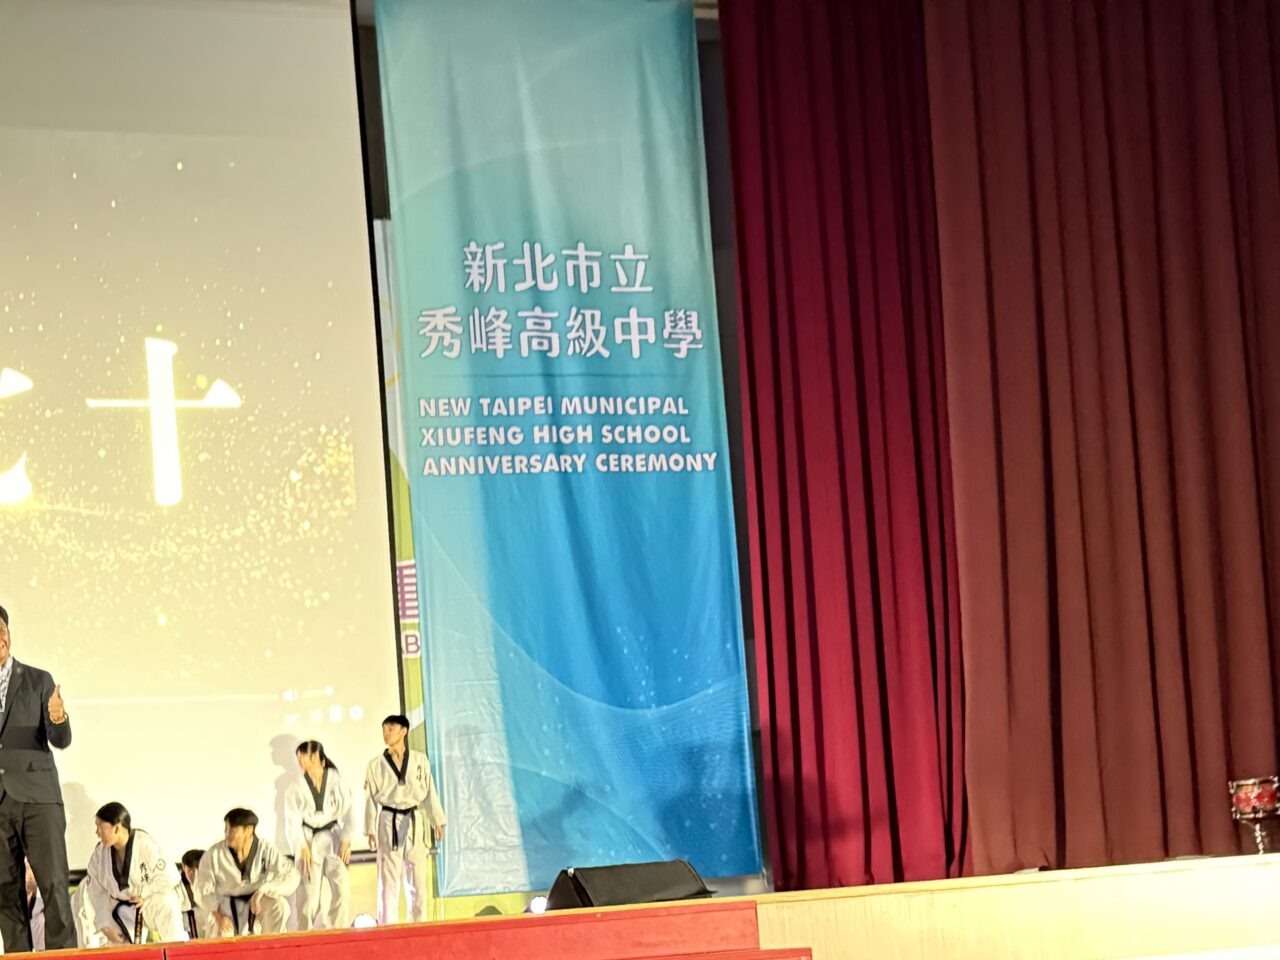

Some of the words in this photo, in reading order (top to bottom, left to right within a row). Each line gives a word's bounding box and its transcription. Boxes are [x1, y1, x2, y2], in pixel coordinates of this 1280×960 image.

[462, 240, 654, 294] 新北市立
[417, 305, 704, 359] 秀峰高級中學
[419, 397, 471, 417] NEW
[479, 396, 553, 416] TAIPEI
[560, 395, 689, 416] MUNICIPAL
[421, 425, 524, 447] XIUFENG
[533, 424, 593, 445] HIGH
[601, 423, 691, 444] SCHOOL
[422, 452, 587, 476] ANNIVERSARY
[595, 451, 718, 473] CEREMONY
